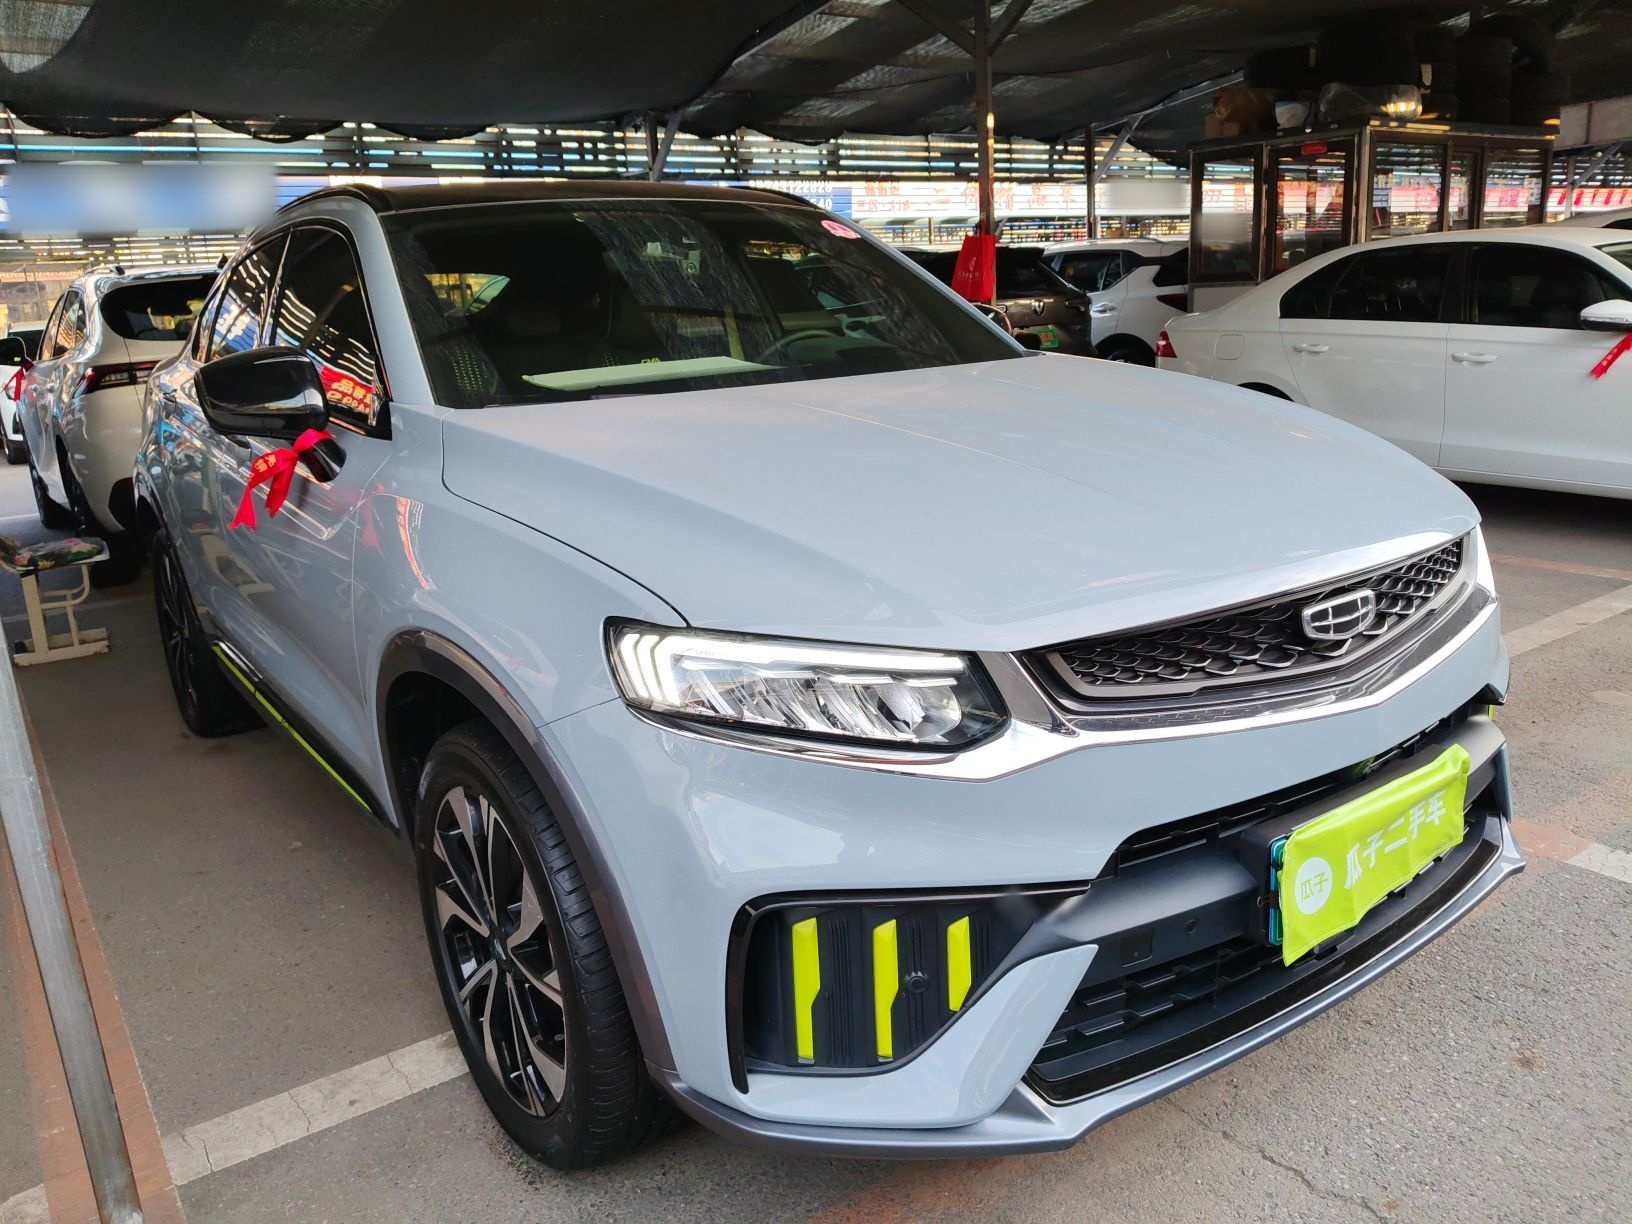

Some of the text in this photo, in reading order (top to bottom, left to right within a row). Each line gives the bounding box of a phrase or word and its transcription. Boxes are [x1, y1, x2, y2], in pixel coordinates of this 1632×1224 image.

[1344, 790, 1446, 889] 瓜子二手车
[1300, 872, 1329, 901] 瓜子
